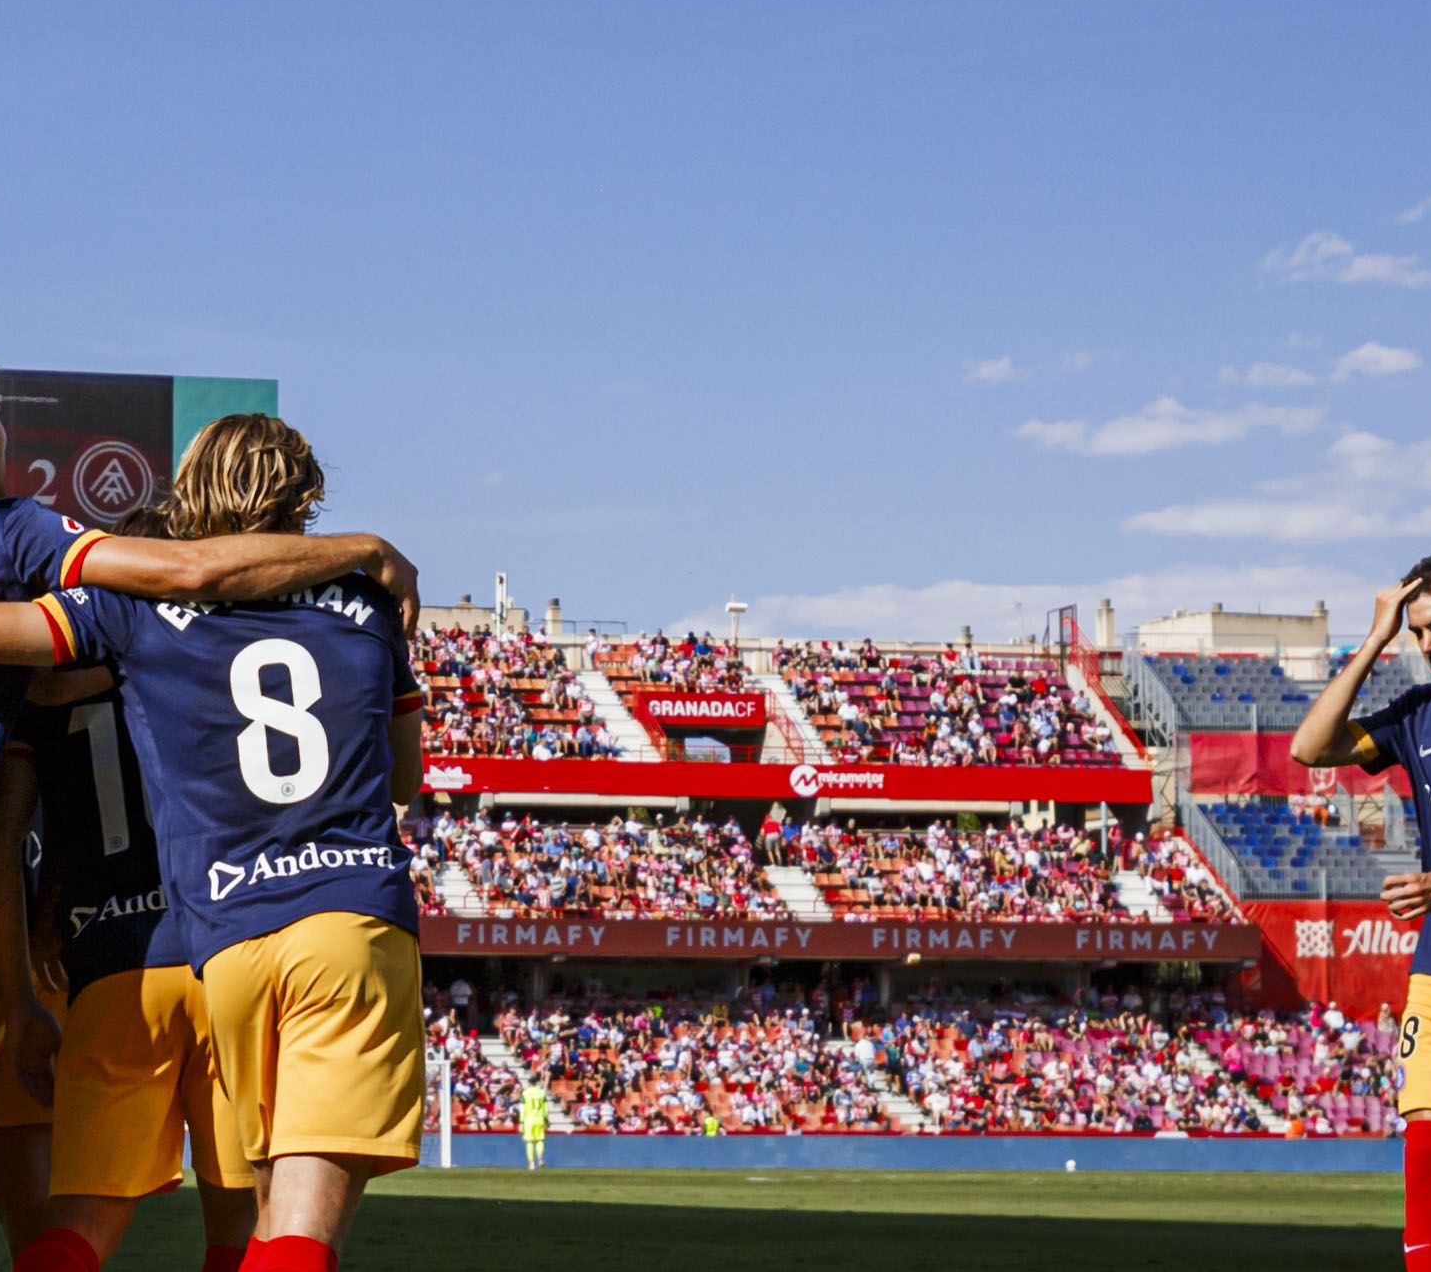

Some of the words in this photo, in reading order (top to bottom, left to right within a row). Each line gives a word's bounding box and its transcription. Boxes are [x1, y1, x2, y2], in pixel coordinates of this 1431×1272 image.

[28, 459, 58, 505] 2
[230, 638, 329, 804] 8
[68, 702, 130, 856] 1
[247, 842, 396, 886] Andorra
[458, 923, 606, 946] FIRMAFY
[666, 926, 813, 948] FIRMAFY
[872, 928, 1018, 949] FIRMAFY
[1076, 930, 1219, 951] FIRMAFY
